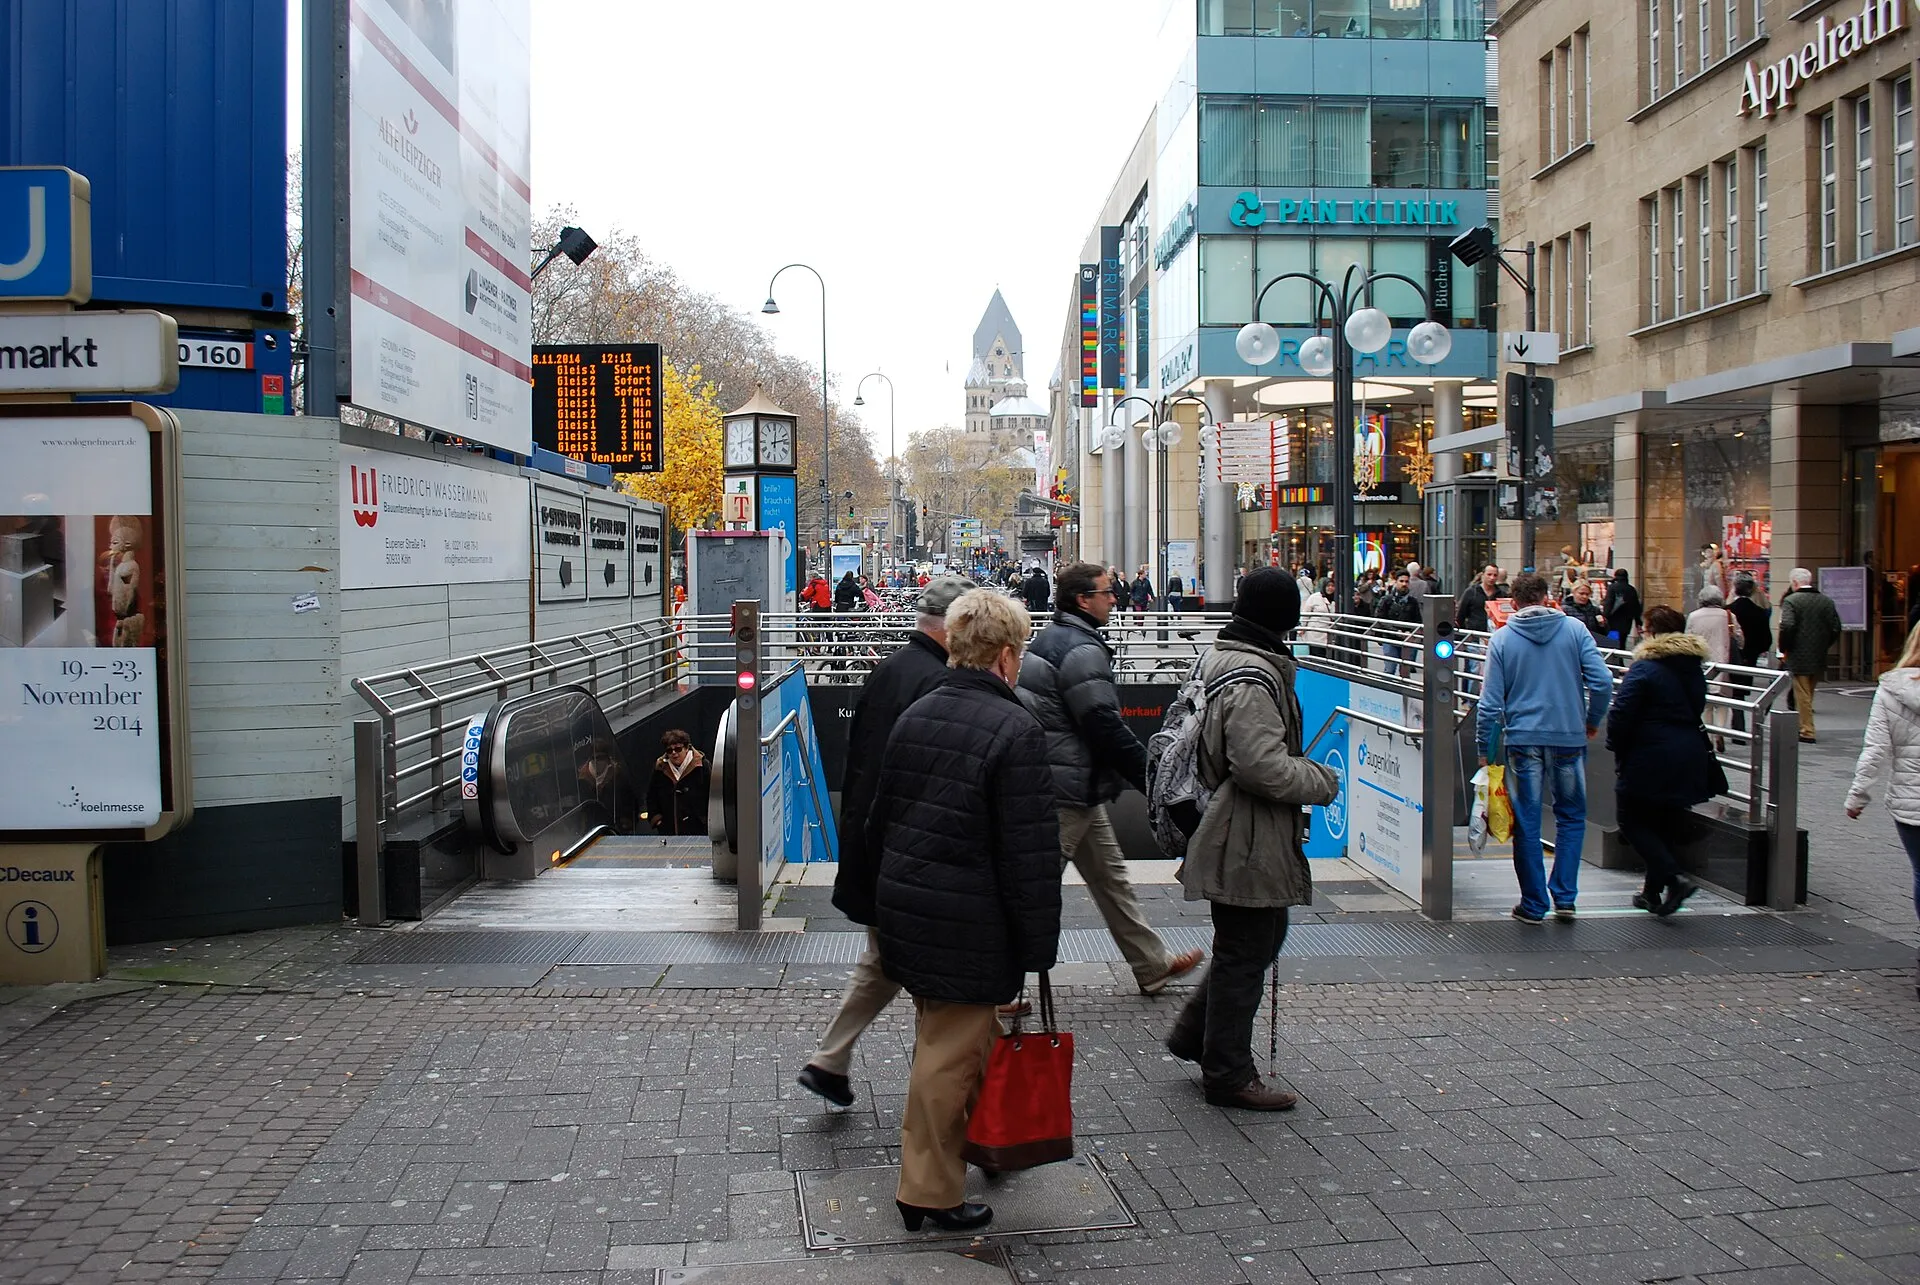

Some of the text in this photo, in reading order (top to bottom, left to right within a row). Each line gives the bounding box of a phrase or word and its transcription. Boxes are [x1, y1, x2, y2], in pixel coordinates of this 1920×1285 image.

[1735, 0, 1903, 119] Appelrath
[379, 116, 442, 189] ALTE LEIPZIGER
[1279, 198, 1460, 225] PAN KLINIK
[1435, 258, 1448, 308] Bücher
[1104, 258, 1117, 355] PRIMARK
[0, 336, 98, 369] markt
[196, 345, 241, 365] 160
[601, 353, 632, 363] 12:13
[557, 364, 651, 375] Gleis 3 Sofort
[557, 376, 651, 386] Gleis 2 Sofort
[557, 387, 651, 397] Gleis 4 Sofort
[557, 398, 652, 408] Gleis 1 1 Min
[557, 409, 652, 419] Gleis 2 2 Min
[558, 420, 652, 430] Gleis 1 2 Min
[558, 431, 652, 440] Gleis 3 3 Min
[558, 442, 652, 452] Gleis 3 3 Min
[591, 452, 634, 463] Venloer
[640, 452, 652, 462] St
[382, 474, 488, 504] FRIEDRICH WASSERMANN
[764, 496, 792, 504] brauch ich
[385, 537, 404, 550] Eupener
[112, 660, 142, 678] 23.
[22, 682, 142, 706] November
[1120, 705, 1162, 717] Verkauf
[93, 714, 142, 737] 2014
[80, 800, 145, 814] koelnmesse
